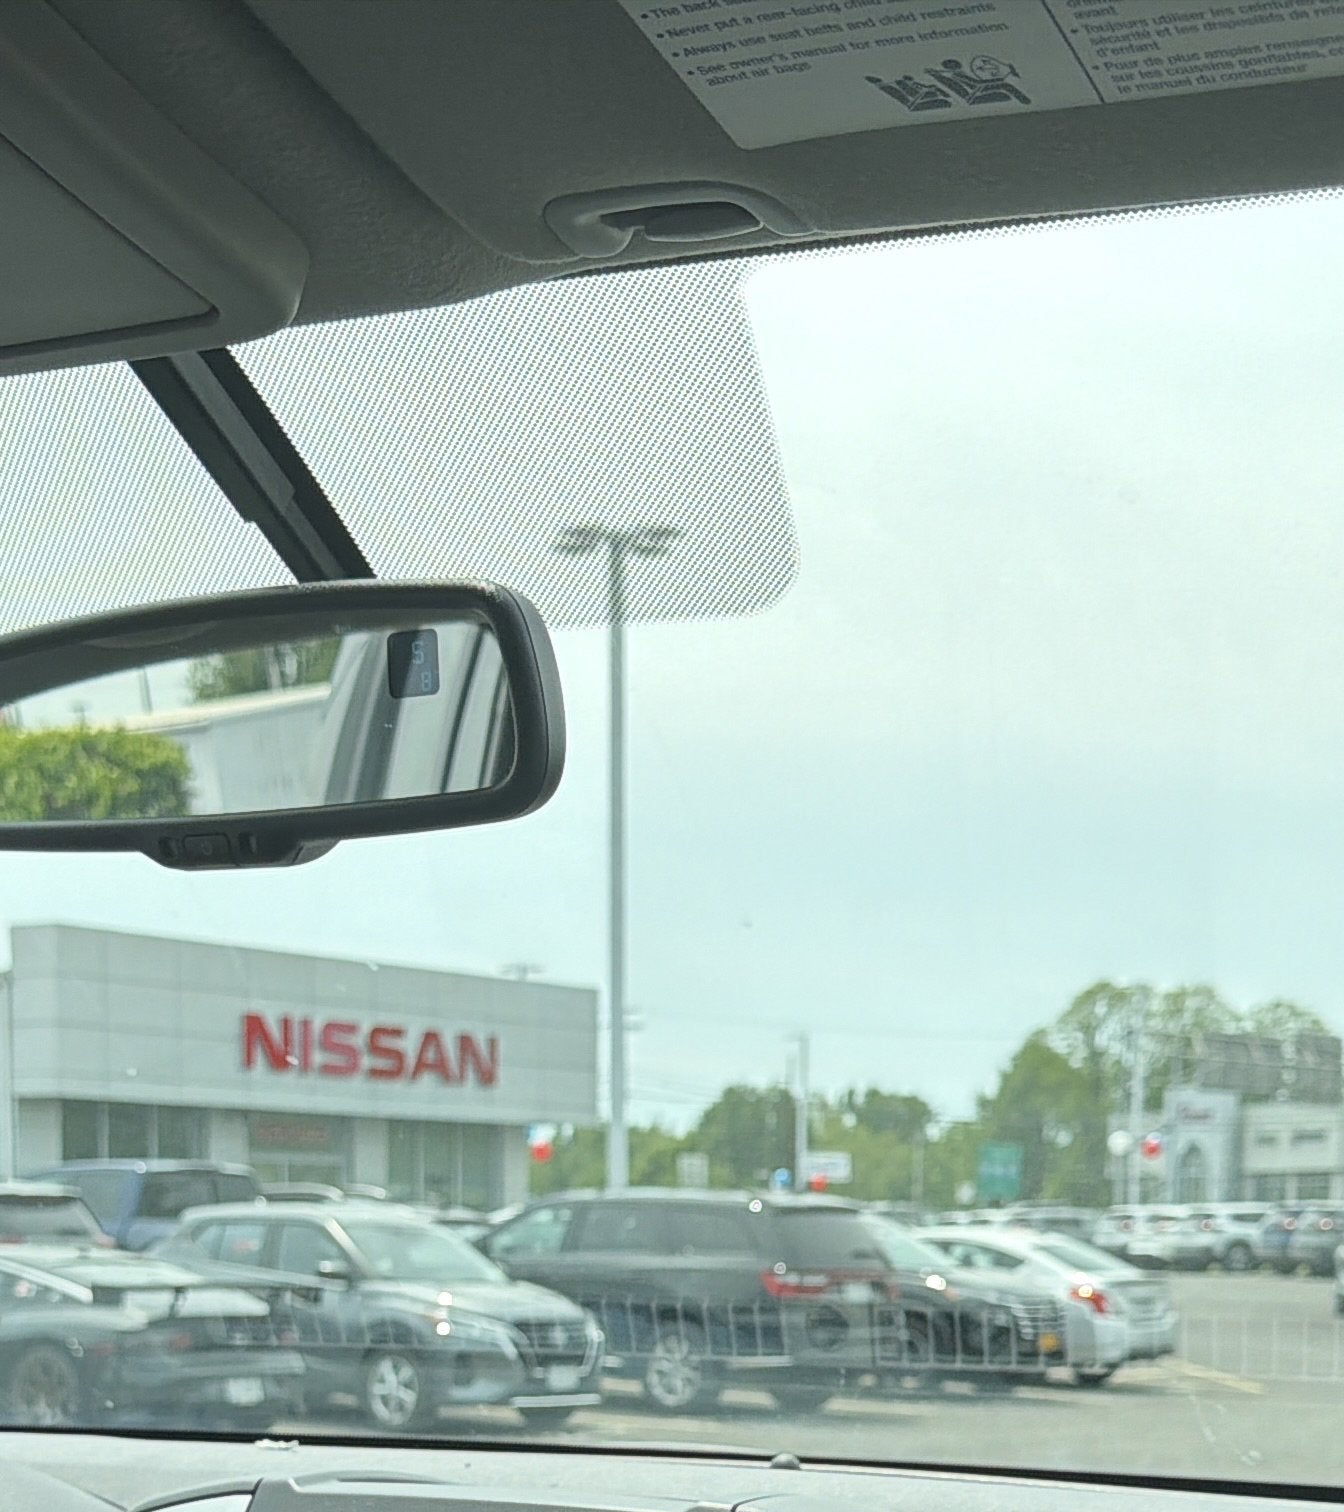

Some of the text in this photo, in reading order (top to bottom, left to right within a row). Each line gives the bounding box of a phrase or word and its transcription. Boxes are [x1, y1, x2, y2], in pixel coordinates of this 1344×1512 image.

[666, 24, 709, 40] Never
[714, 17, 743, 34] put
[756, 3, 842, 25] rear-facing
[682, 1, 996, 59] Always use seat belts and child restraints
[1083, 16, 1150, 35] Toujours
[1152, 10, 1206, 27] utiliser
[1155, 26, 1173, 39] et
[1175, 21, 1201, 35] les
[1288, 9, 1310, 21] de
[697, 21, 1009, 76] See owner's manual for more information
[1096, 39, 1160, 58] d'enfant
[1104, 58, 1140, 73] Pour
[1142, 55, 1164, 67] de
[1168, 49, 1201, 66] plus
[705, 60, 812, 86] about air bags
[1111, 70, 1136, 83] sur
[1166, 59, 1235, 77] coussins
[1116, 62, 1309, 95] le manuel du conducteur
[241, 1010, 501, 1087] NISSAN
